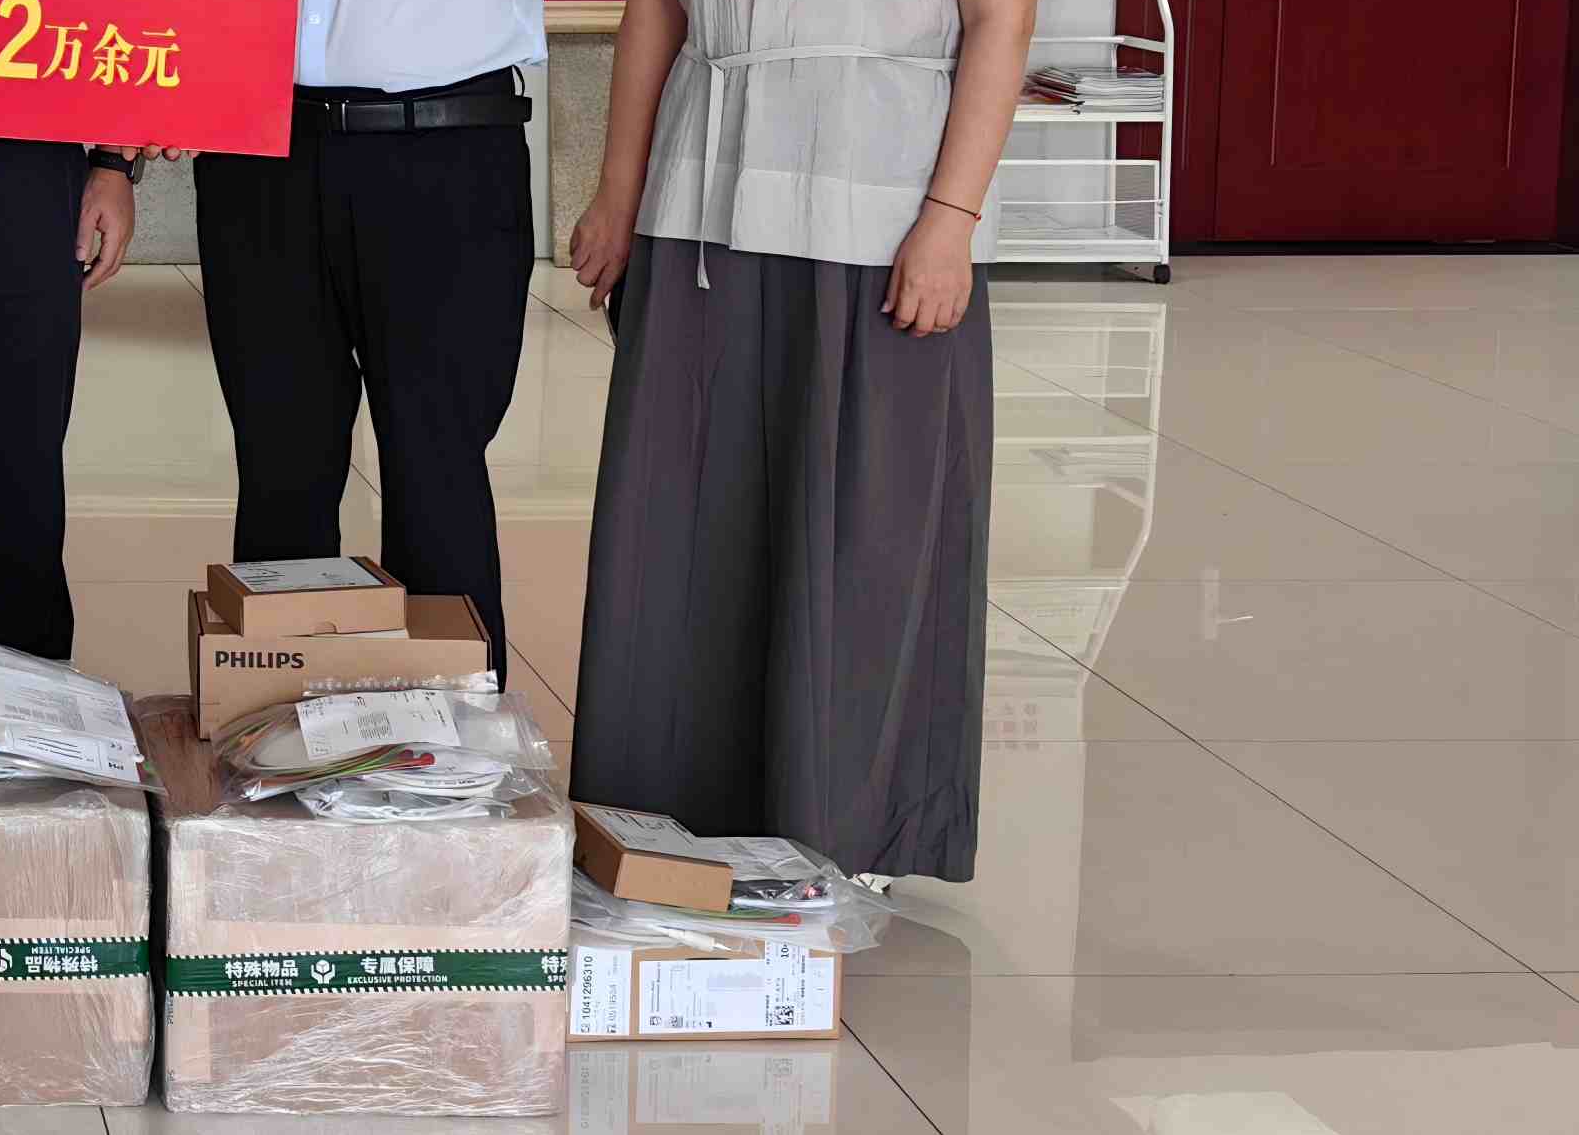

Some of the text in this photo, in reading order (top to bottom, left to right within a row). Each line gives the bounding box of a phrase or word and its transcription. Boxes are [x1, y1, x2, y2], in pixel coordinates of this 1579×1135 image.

[215, 650, 305, 669] PHILIPS
[31, 946, 91, 954] SPECIAL ITEM
[780, 943, 790, 958] 10
[25, 955, 98, 973] 特殊物品
[225, 959, 299, 979] 特殊物品
[361, 956, 434, 974] 专属保障
[232, 978, 293, 987] SPECIAL ITEM
[347, 974, 448, 984] EXCLUSIVE PROTECTION
